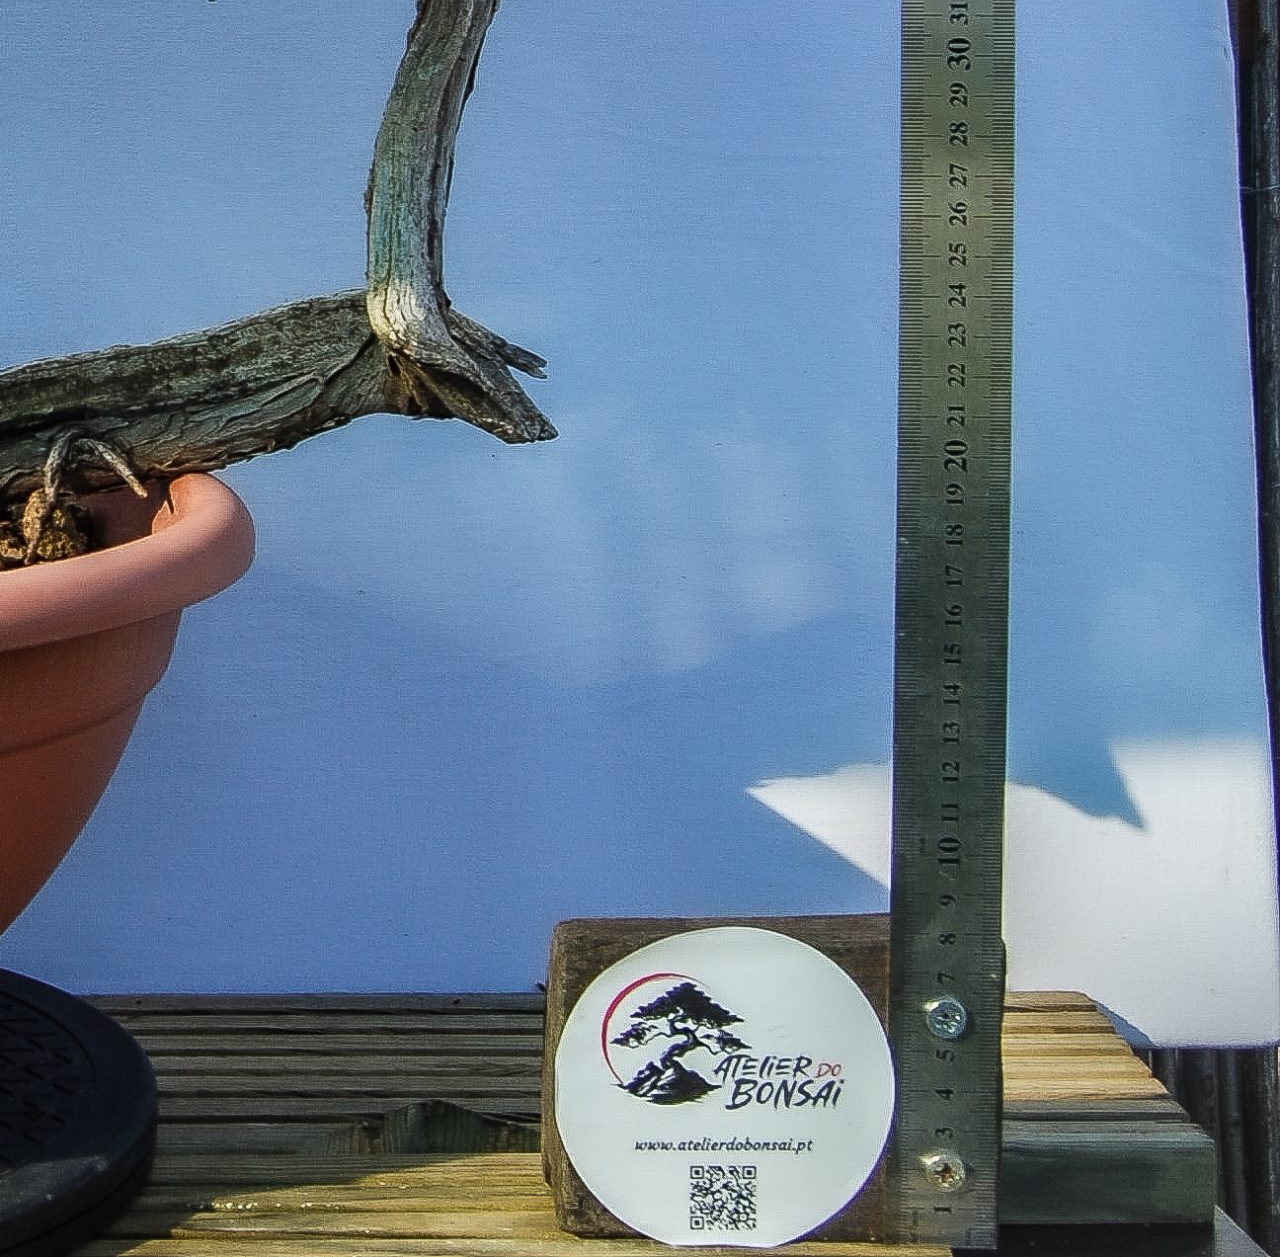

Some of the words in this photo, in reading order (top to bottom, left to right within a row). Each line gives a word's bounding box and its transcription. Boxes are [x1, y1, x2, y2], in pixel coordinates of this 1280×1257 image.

[949, 3, 969, 25] 31
[947, 37, 971, 71] 30
[949, 82, 968, 107] 29
[949, 122, 968, 146] 28
[949, 163, 968, 188] 27
[949, 202, 968, 227] 26
[948, 242, 967, 268] 25
[948, 283, 967, 308] 24
[948, 322, 967, 348] 23
[948, 362, 967, 388] 22
[947, 405, 965, 427] 21
[944, 440, 968, 473] 20
[946, 483, 965, 506] 19
[945, 523, 964, 546] 18
[945, 565, 963, 586] 17
[944, 604, 963, 626] 16
[943, 643, 962, 664] 15
[943, 683, 962, 705] 14
[942, 721, 961, 743] 13
[941, 761, 960, 783] 12
[940, 803, 959, 822] 11
[937, 837, 961, 864] 10
[939, 894, 957, 907] 9
[938, 932, 957, 945] 8
[937, 972, 956, 985] 7
[936, 1049, 955, 1062] 5
[815, 1062, 842, 1078] DO
[934, 1089, 954, 1101] 4
[934, 1127, 954, 1139] 3
[634, 1136, 814, 1155] www.atelierdobonsai.pt
